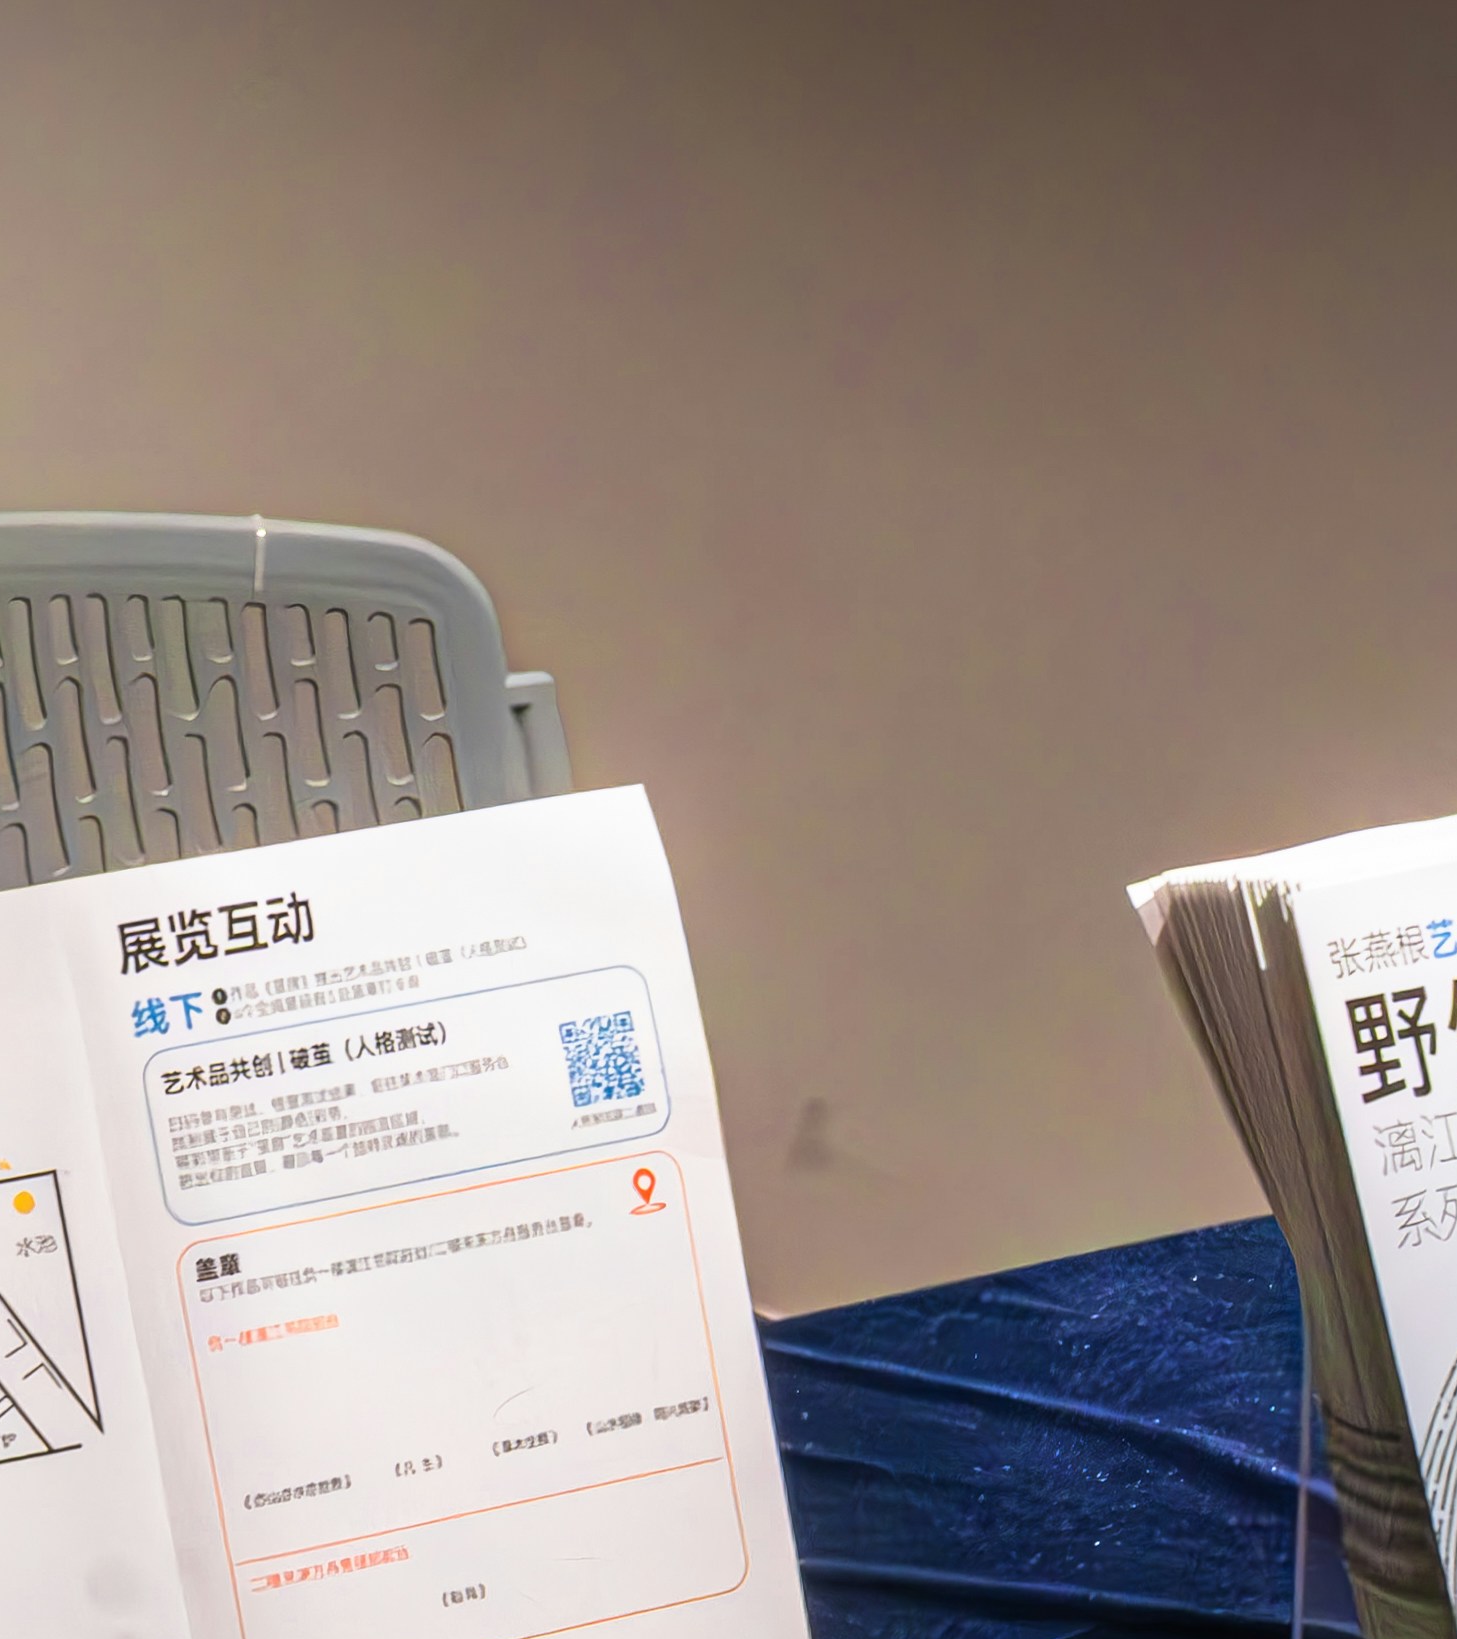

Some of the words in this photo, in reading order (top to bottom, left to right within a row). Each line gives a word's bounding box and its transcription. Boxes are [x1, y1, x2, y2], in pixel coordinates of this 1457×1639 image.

[117, 891, 315, 976] 展览互动
[131, 992, 203, 1038] 线下
